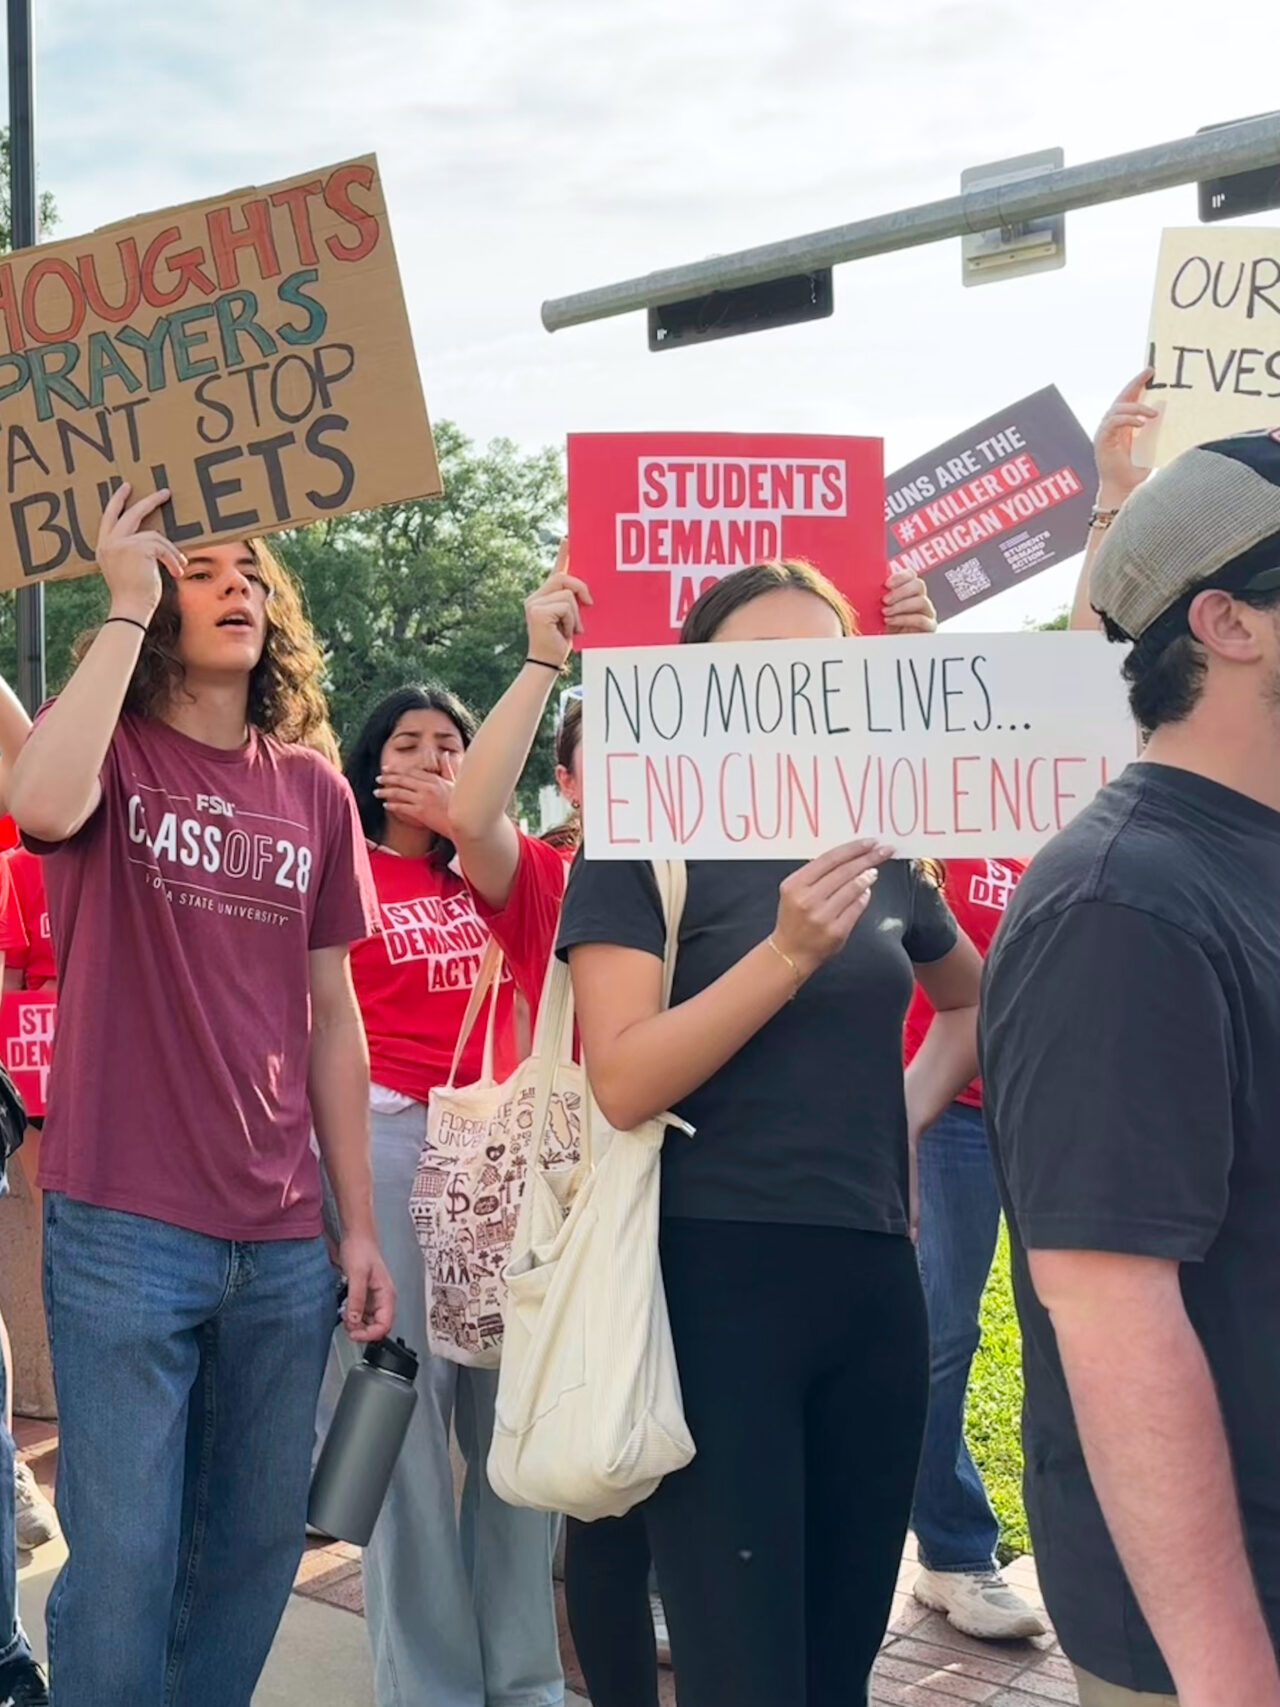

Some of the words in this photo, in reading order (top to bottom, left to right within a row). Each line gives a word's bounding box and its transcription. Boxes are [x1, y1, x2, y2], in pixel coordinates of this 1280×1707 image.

[1171, 256, 1280, 319] OUR
[197, 343, 355, 443] STOP
[642, 462, 844, 511] STUDENTS
[935, 450, 982, 490] ARE
[976, 425, 1027, 463] THE
[11, 414, 356, 577] BULETS
[898, 513, 928, 543] #1
[926, 481, 1008, 528] KILLER
[1000, 455, 1035, 487] OF
[999, 467, 1080, 524] YOUTH
[621, 519, 778, 565] DEMAND
[605, 663, 683, 743] NO
[703, 659, 850, 738] MORE
[196, 794, 233, 818] FSU
[606, 752, 705, 845] END
[719, 752, 820, 843] GUN
